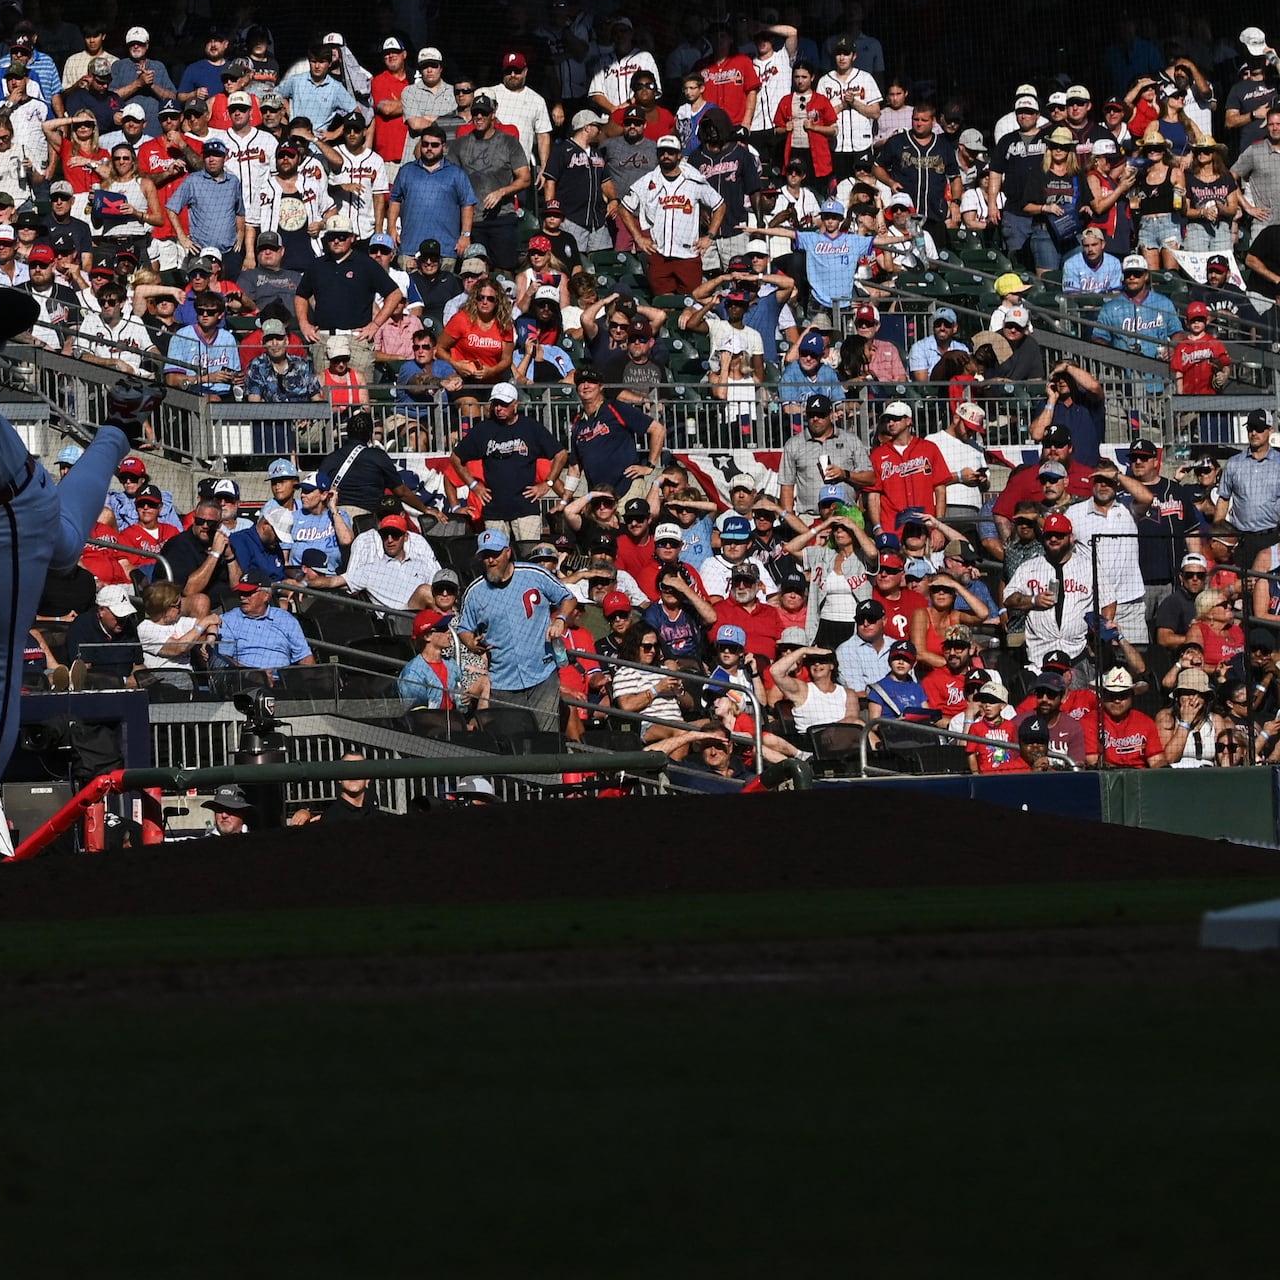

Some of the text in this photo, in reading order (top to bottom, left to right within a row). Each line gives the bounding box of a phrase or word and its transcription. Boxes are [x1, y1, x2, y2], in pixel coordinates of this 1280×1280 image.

[815, 242, 848, 255] Atlanta
[881, 459, 924, 479] Braves
[522, 588, 540, 618] P
[891, 615, 907, 637] P
